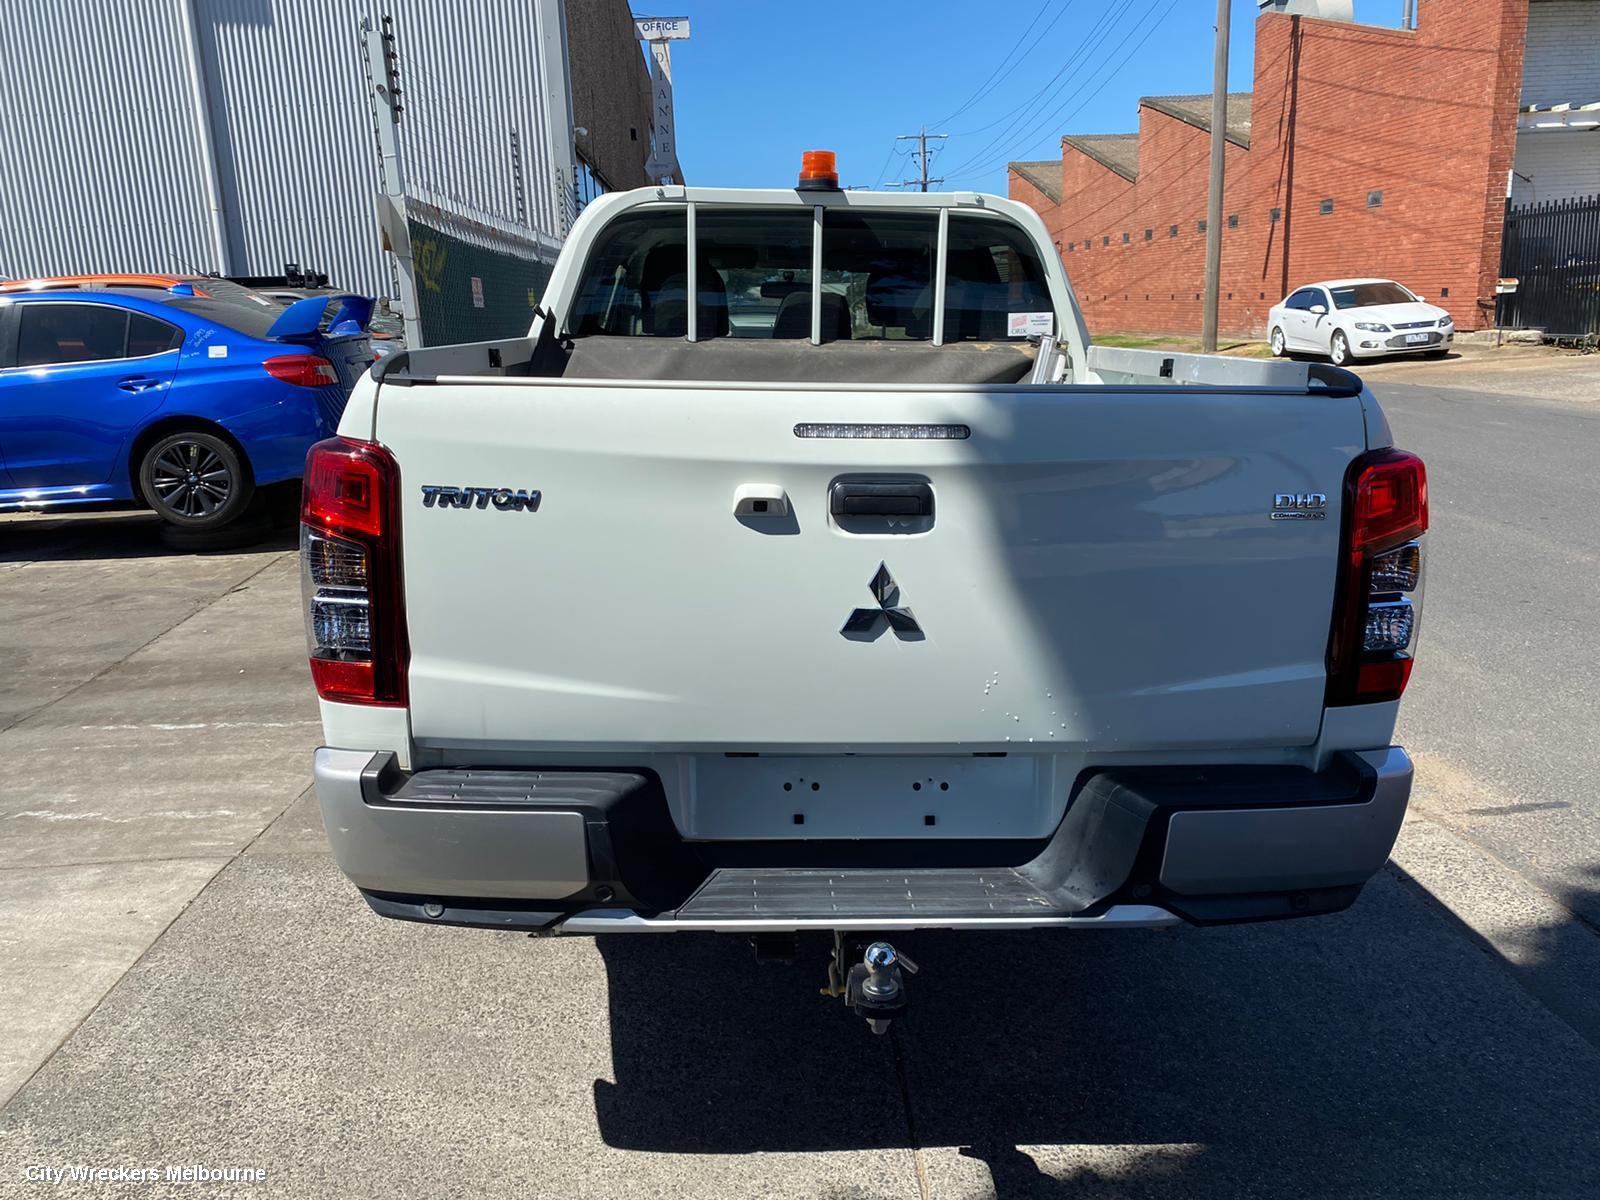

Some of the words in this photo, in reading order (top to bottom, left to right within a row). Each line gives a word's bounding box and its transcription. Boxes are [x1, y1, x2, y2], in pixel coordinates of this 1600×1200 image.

[642, 21, 679, 32] OFFICE
[655, 51, 671, 153] DIANNE
[421, 484, 542, 513] TRITON
